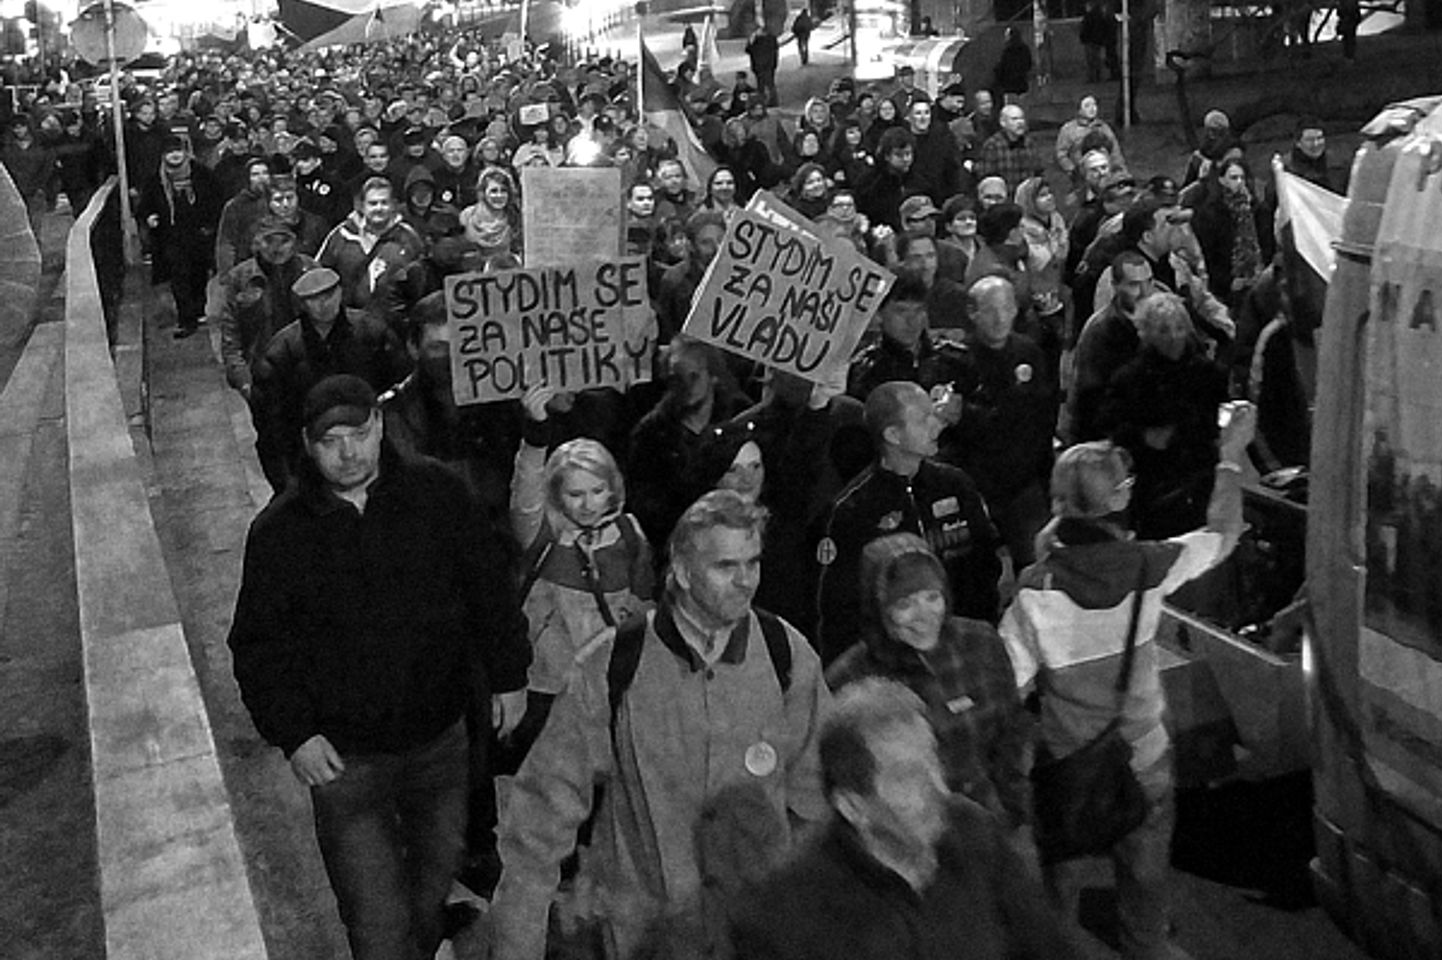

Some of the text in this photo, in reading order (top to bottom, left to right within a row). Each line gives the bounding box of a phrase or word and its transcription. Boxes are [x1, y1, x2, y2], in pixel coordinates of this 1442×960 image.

[451, 263, 642, 319] STYDIM SE
[723, 265, 772, 307] ZA
[836, 266, 882, 312] SE
[459, 306, 610, 354] ZA NAŠE
[463, 337, 649, 399] POLITIKY
